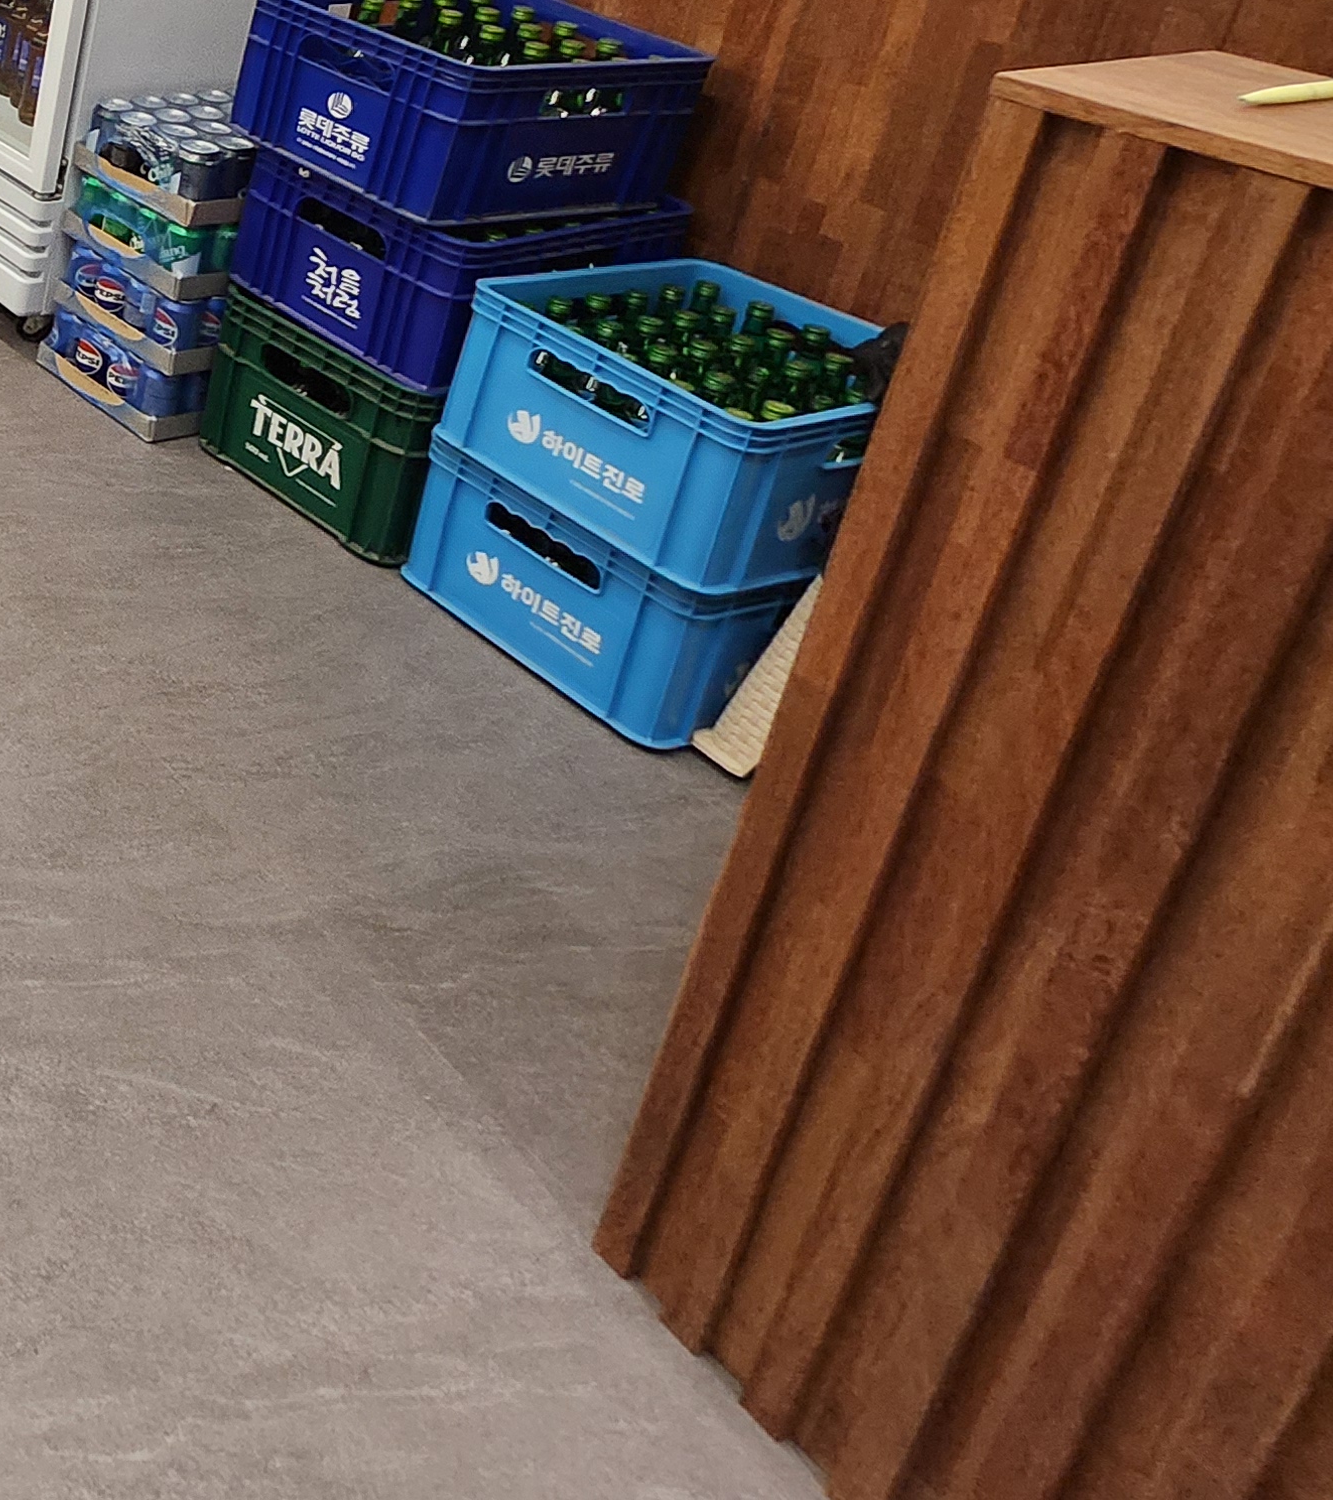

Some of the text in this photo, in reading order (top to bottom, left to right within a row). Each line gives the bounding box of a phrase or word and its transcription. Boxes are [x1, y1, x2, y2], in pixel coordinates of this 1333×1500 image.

[298, 107, 370, 153] 롯데주류
[534, 153, 615, 179] 롯데주류
[250, 397, 341, 490] TERRA
[541, 430, 645, 505] 하이트진로
[501, 573, 601, 654] 하이트진로
